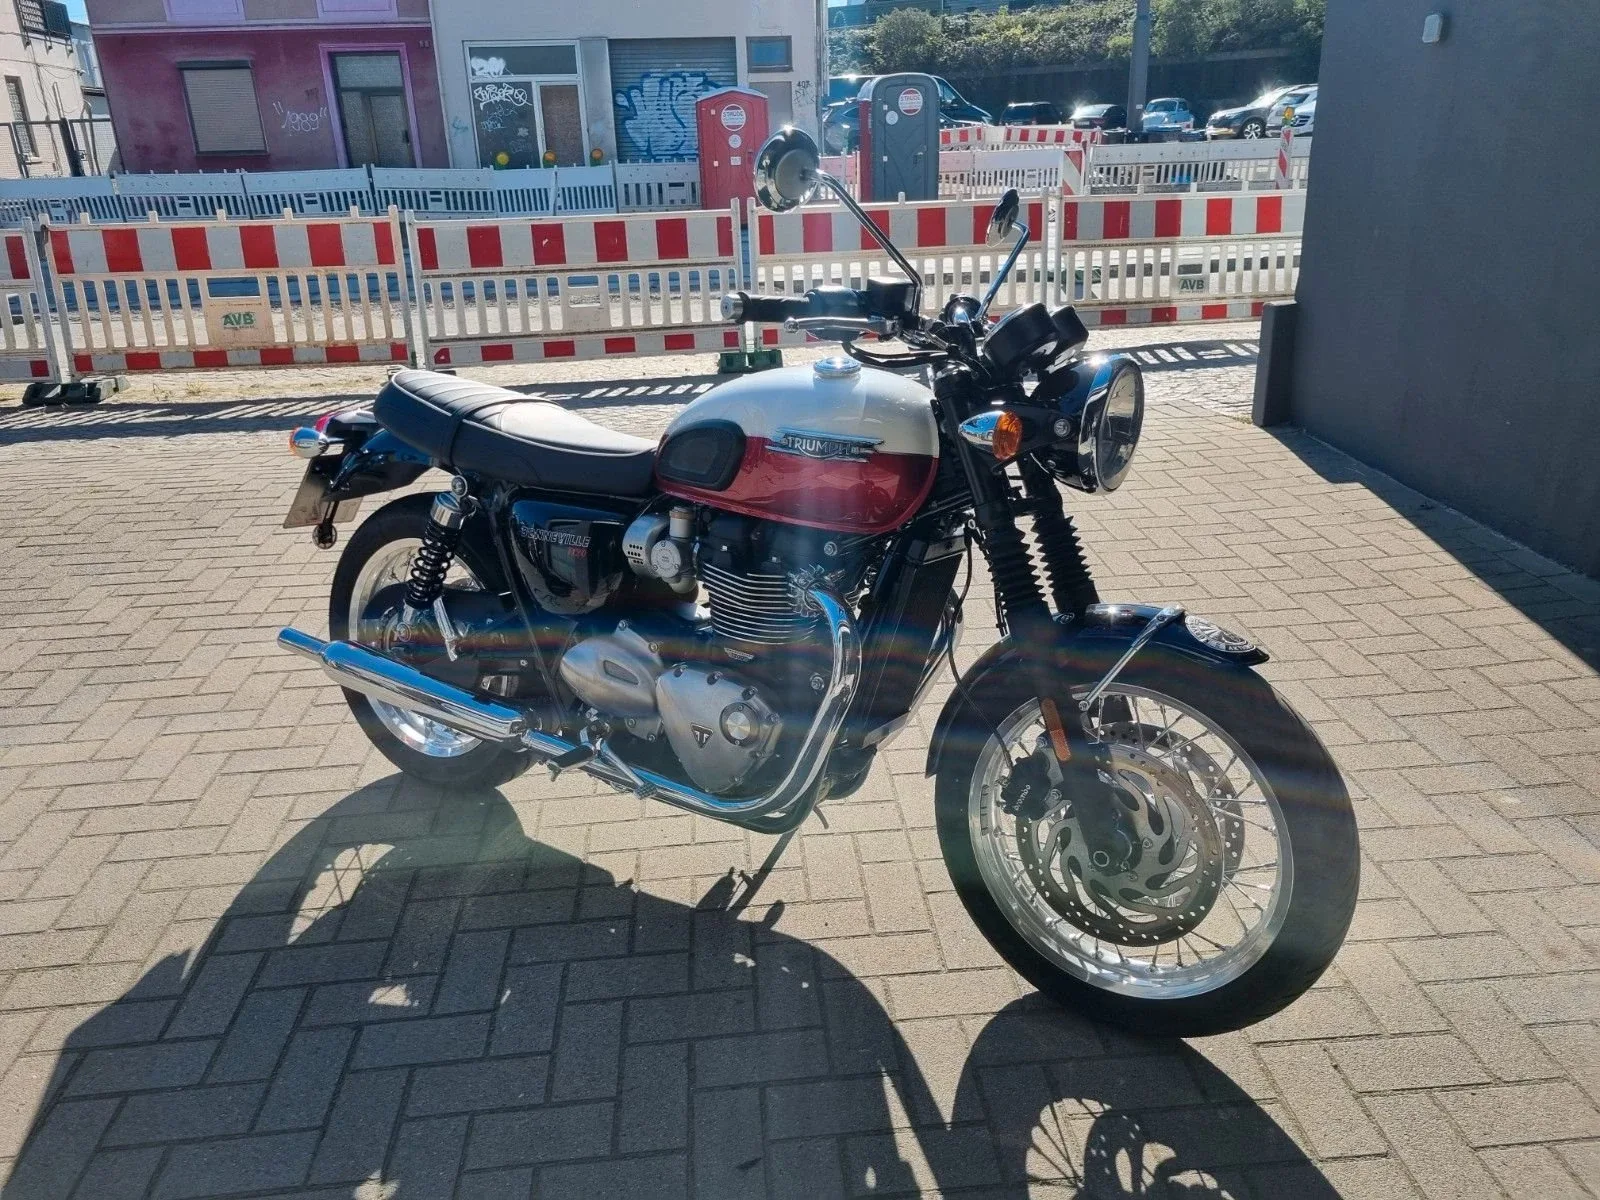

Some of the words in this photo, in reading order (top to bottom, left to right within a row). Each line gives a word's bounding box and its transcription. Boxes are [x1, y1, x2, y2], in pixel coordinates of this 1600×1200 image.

[1180, 279, 1204, 290] AVB
[222, 312, 256, 326] AVB
[786, 436, 851, 455] TRIUMPH
